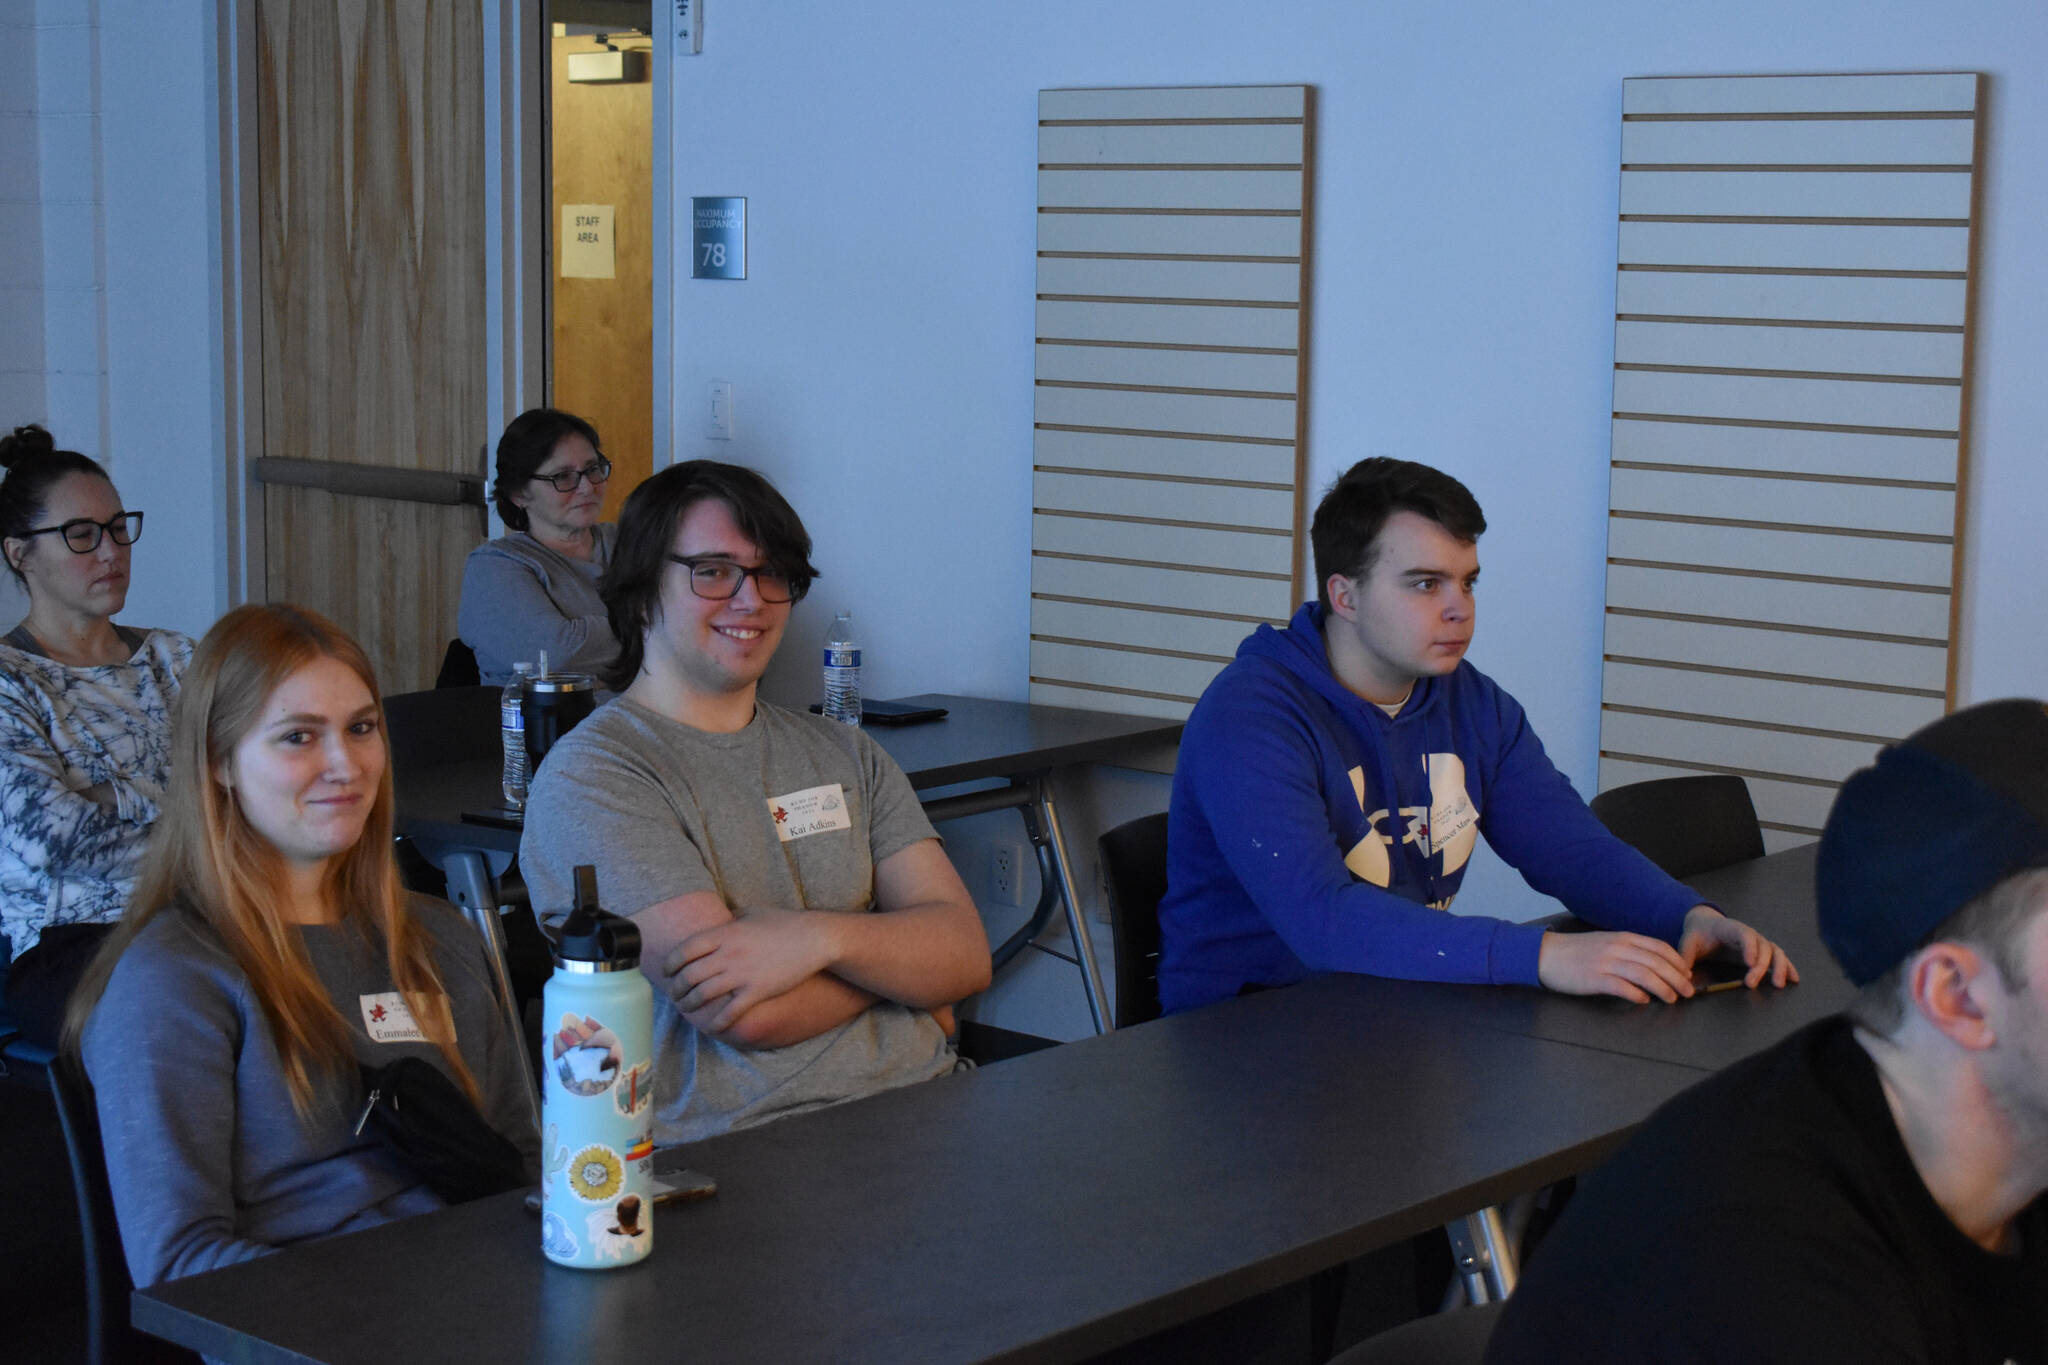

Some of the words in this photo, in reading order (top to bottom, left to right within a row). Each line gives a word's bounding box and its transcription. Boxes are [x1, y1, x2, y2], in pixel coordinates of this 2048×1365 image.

[575, 216, 600, 227] STAFF
[577, 232, 600, 243] AREA
[701, 242, 726, 267] 78
[789, 823, 807, 836] Kai
[808, 818, 837, 832] Adkins
